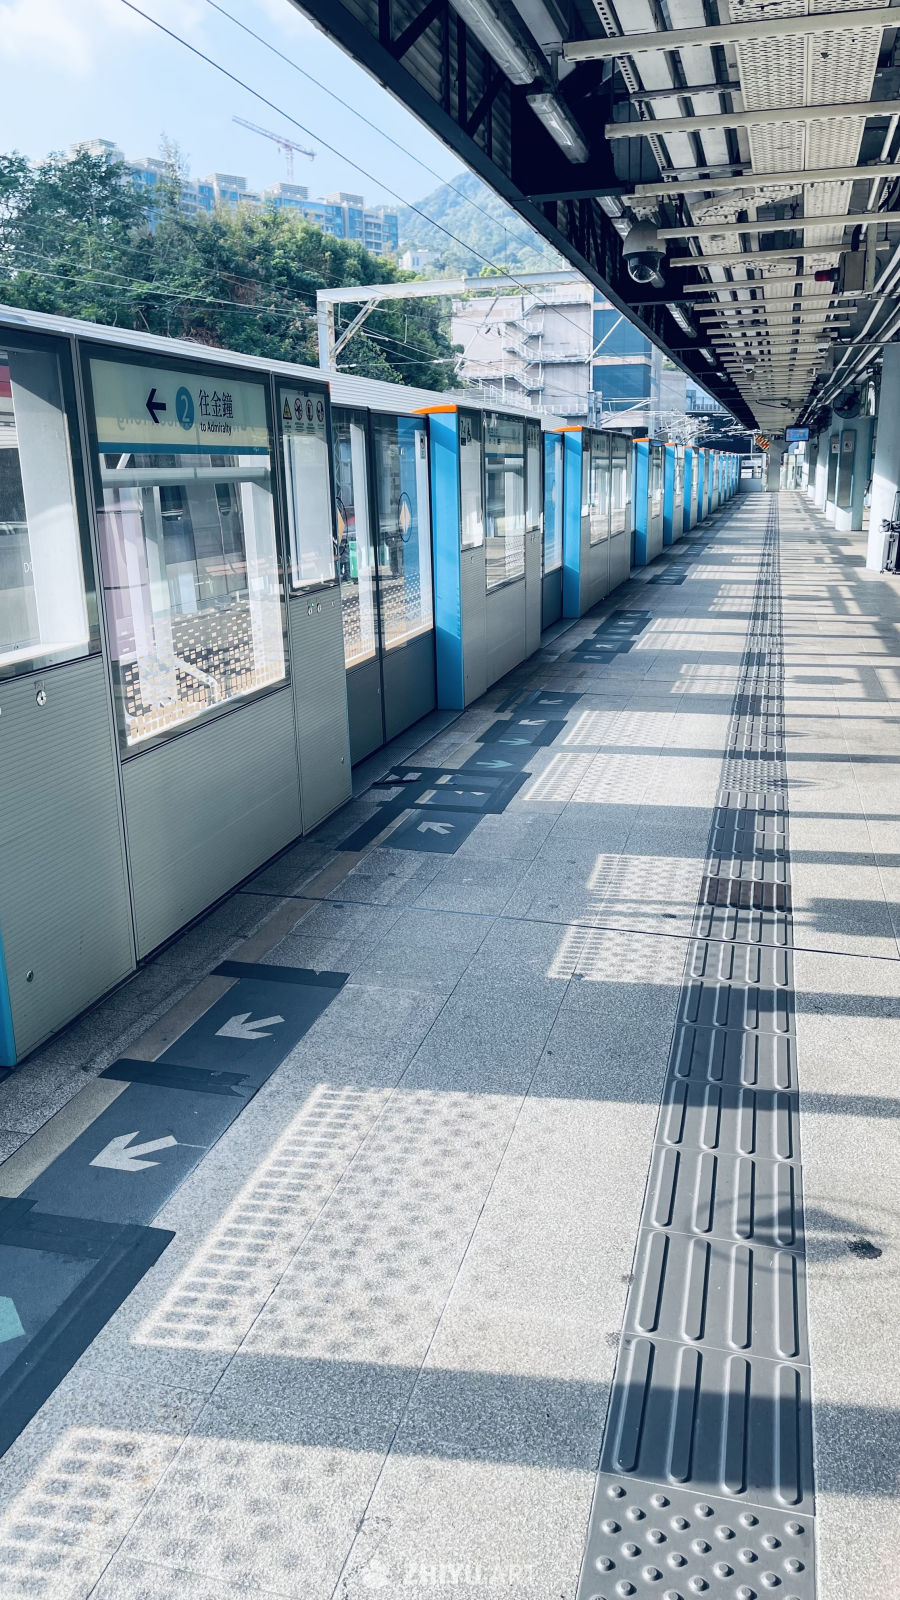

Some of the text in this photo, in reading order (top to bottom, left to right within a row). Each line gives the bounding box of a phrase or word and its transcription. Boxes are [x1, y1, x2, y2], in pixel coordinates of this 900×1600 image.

[180, 388, 234, 422] 2 往金鐘
[200, 422, 207, 432] to
[207, 421, 232, 436] Admiralty
